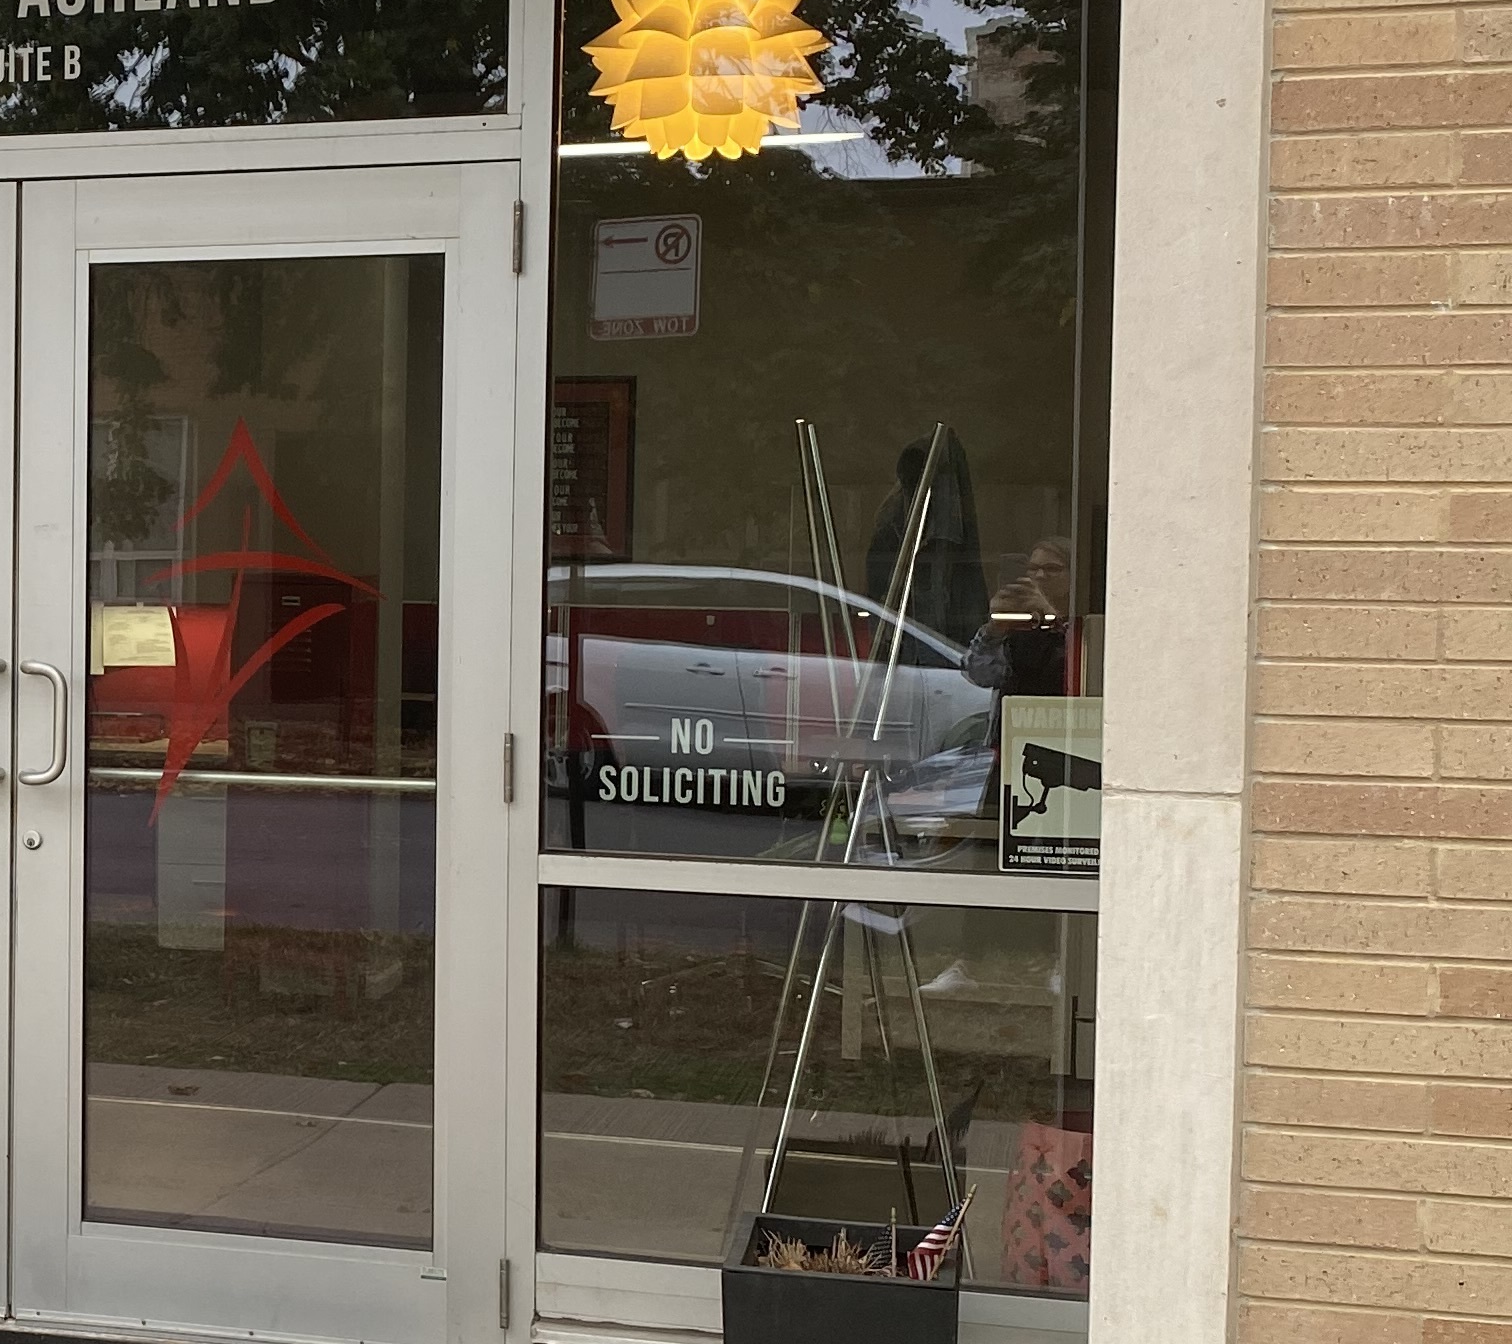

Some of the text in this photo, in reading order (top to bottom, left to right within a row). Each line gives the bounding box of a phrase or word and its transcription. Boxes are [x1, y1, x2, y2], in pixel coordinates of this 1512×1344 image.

[63, 45, 82, 82] B
[1011, 707, 1102, 729] WARNIN
[670, 717, 715, 755] NO
[598, 764, 786, 808] SOLICITING
[1008, 854, 1100, 866] 24 HOUR VIDEO SURVEIL
[1017, 844, 1099, 856] PREMISES MONITORED
